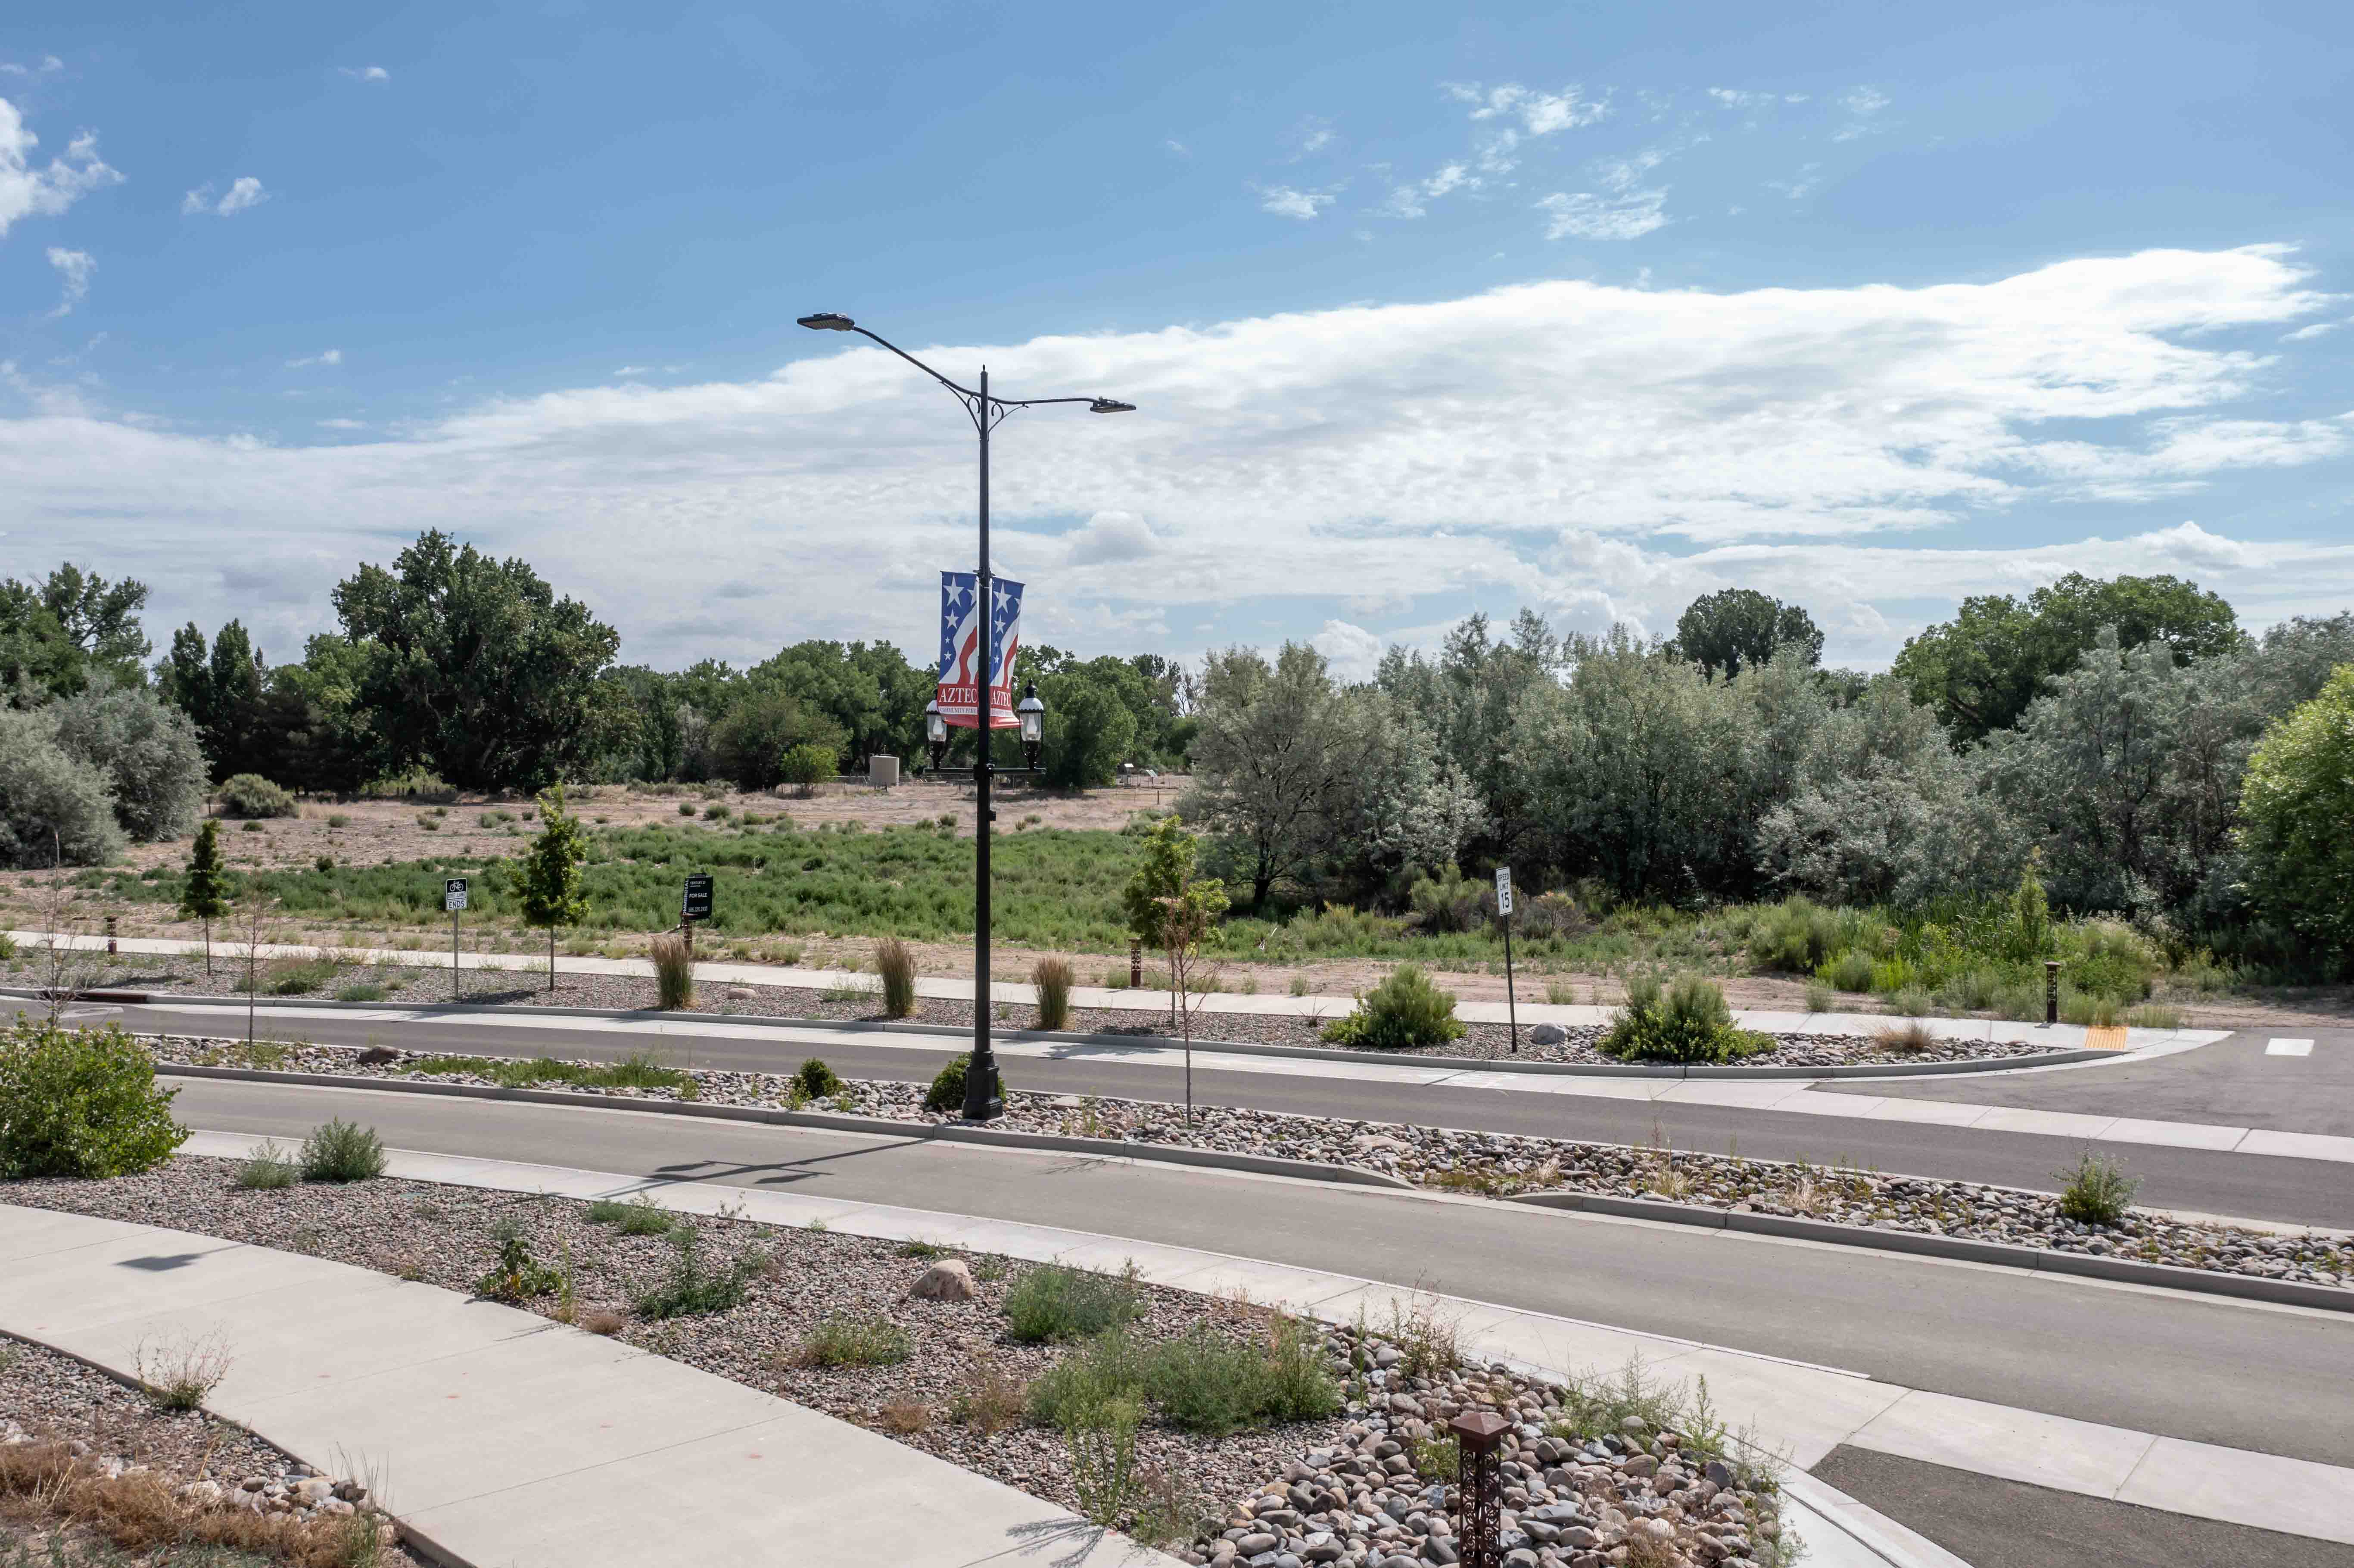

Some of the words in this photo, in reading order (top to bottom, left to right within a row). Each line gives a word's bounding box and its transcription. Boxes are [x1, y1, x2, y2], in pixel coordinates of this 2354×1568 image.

[939, 687, 977, 703] AZTEC
[991, 690, 1011, 707] AZTEC
[1498, 873, 1509, 882] SPEED
[1499, 882, 1509, 890] LIMIT
[449, 900, 464, 908] ENDS
[1501, 892, 1510, 909] 15
